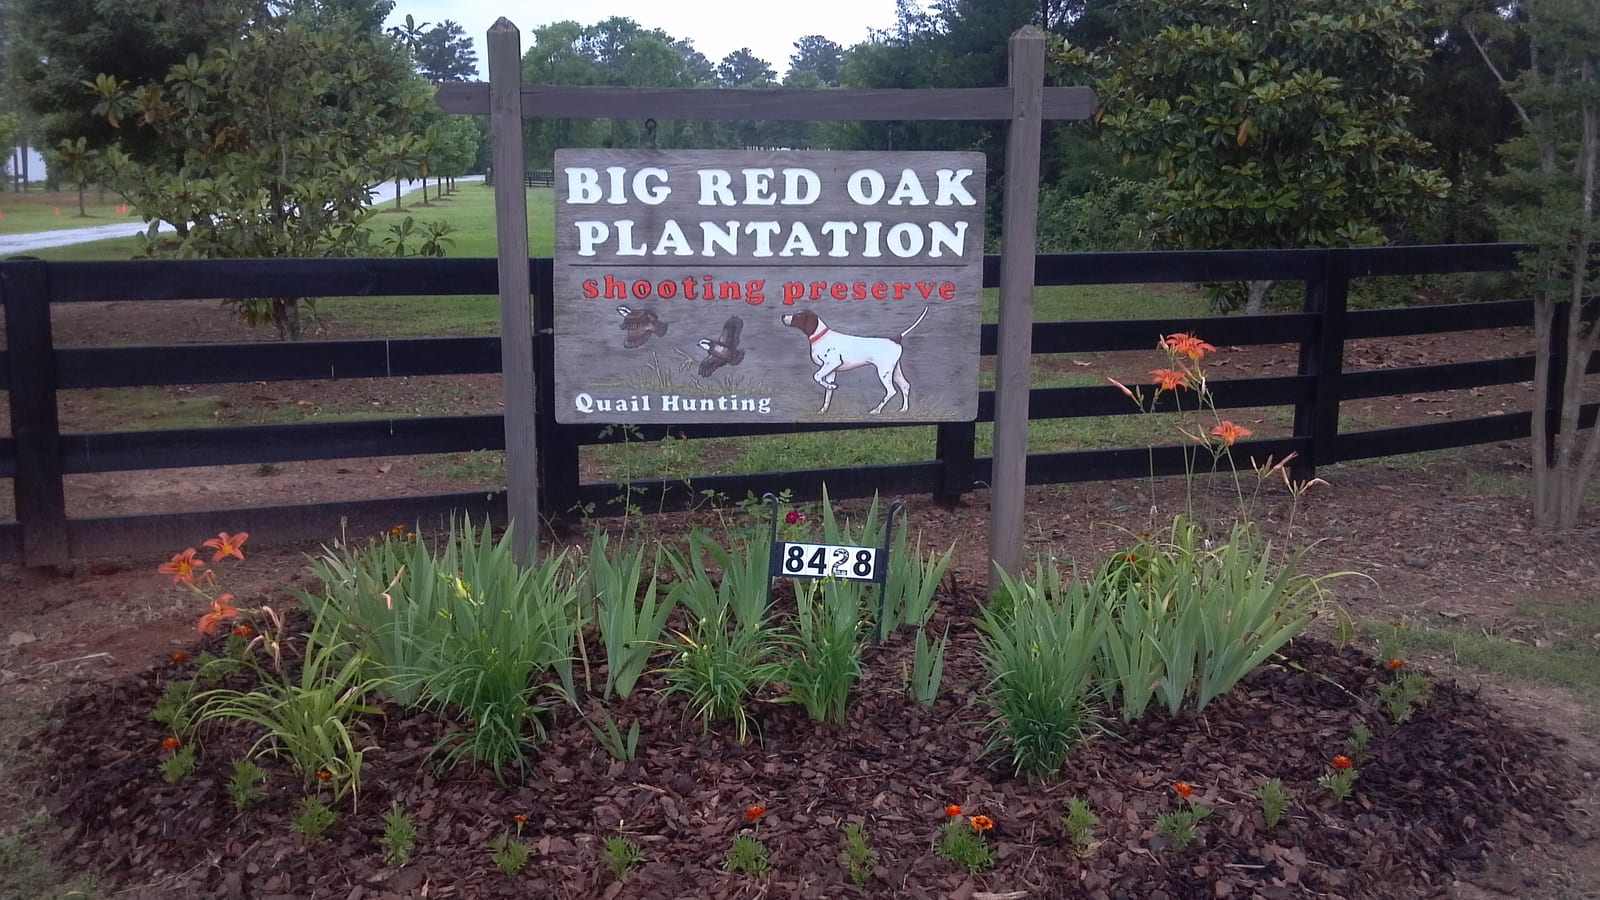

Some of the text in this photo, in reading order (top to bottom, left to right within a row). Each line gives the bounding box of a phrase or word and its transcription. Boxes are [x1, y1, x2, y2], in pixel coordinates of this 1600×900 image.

[564, 167, 977, 207] BIG RED OAK
[574, 219, 969, 259] PLANTATION
[582, 274, 957, 306] shooting preserve
[575, 392, 772, 414] Quail Hunting
[785, 545, 872, 577] 8428
